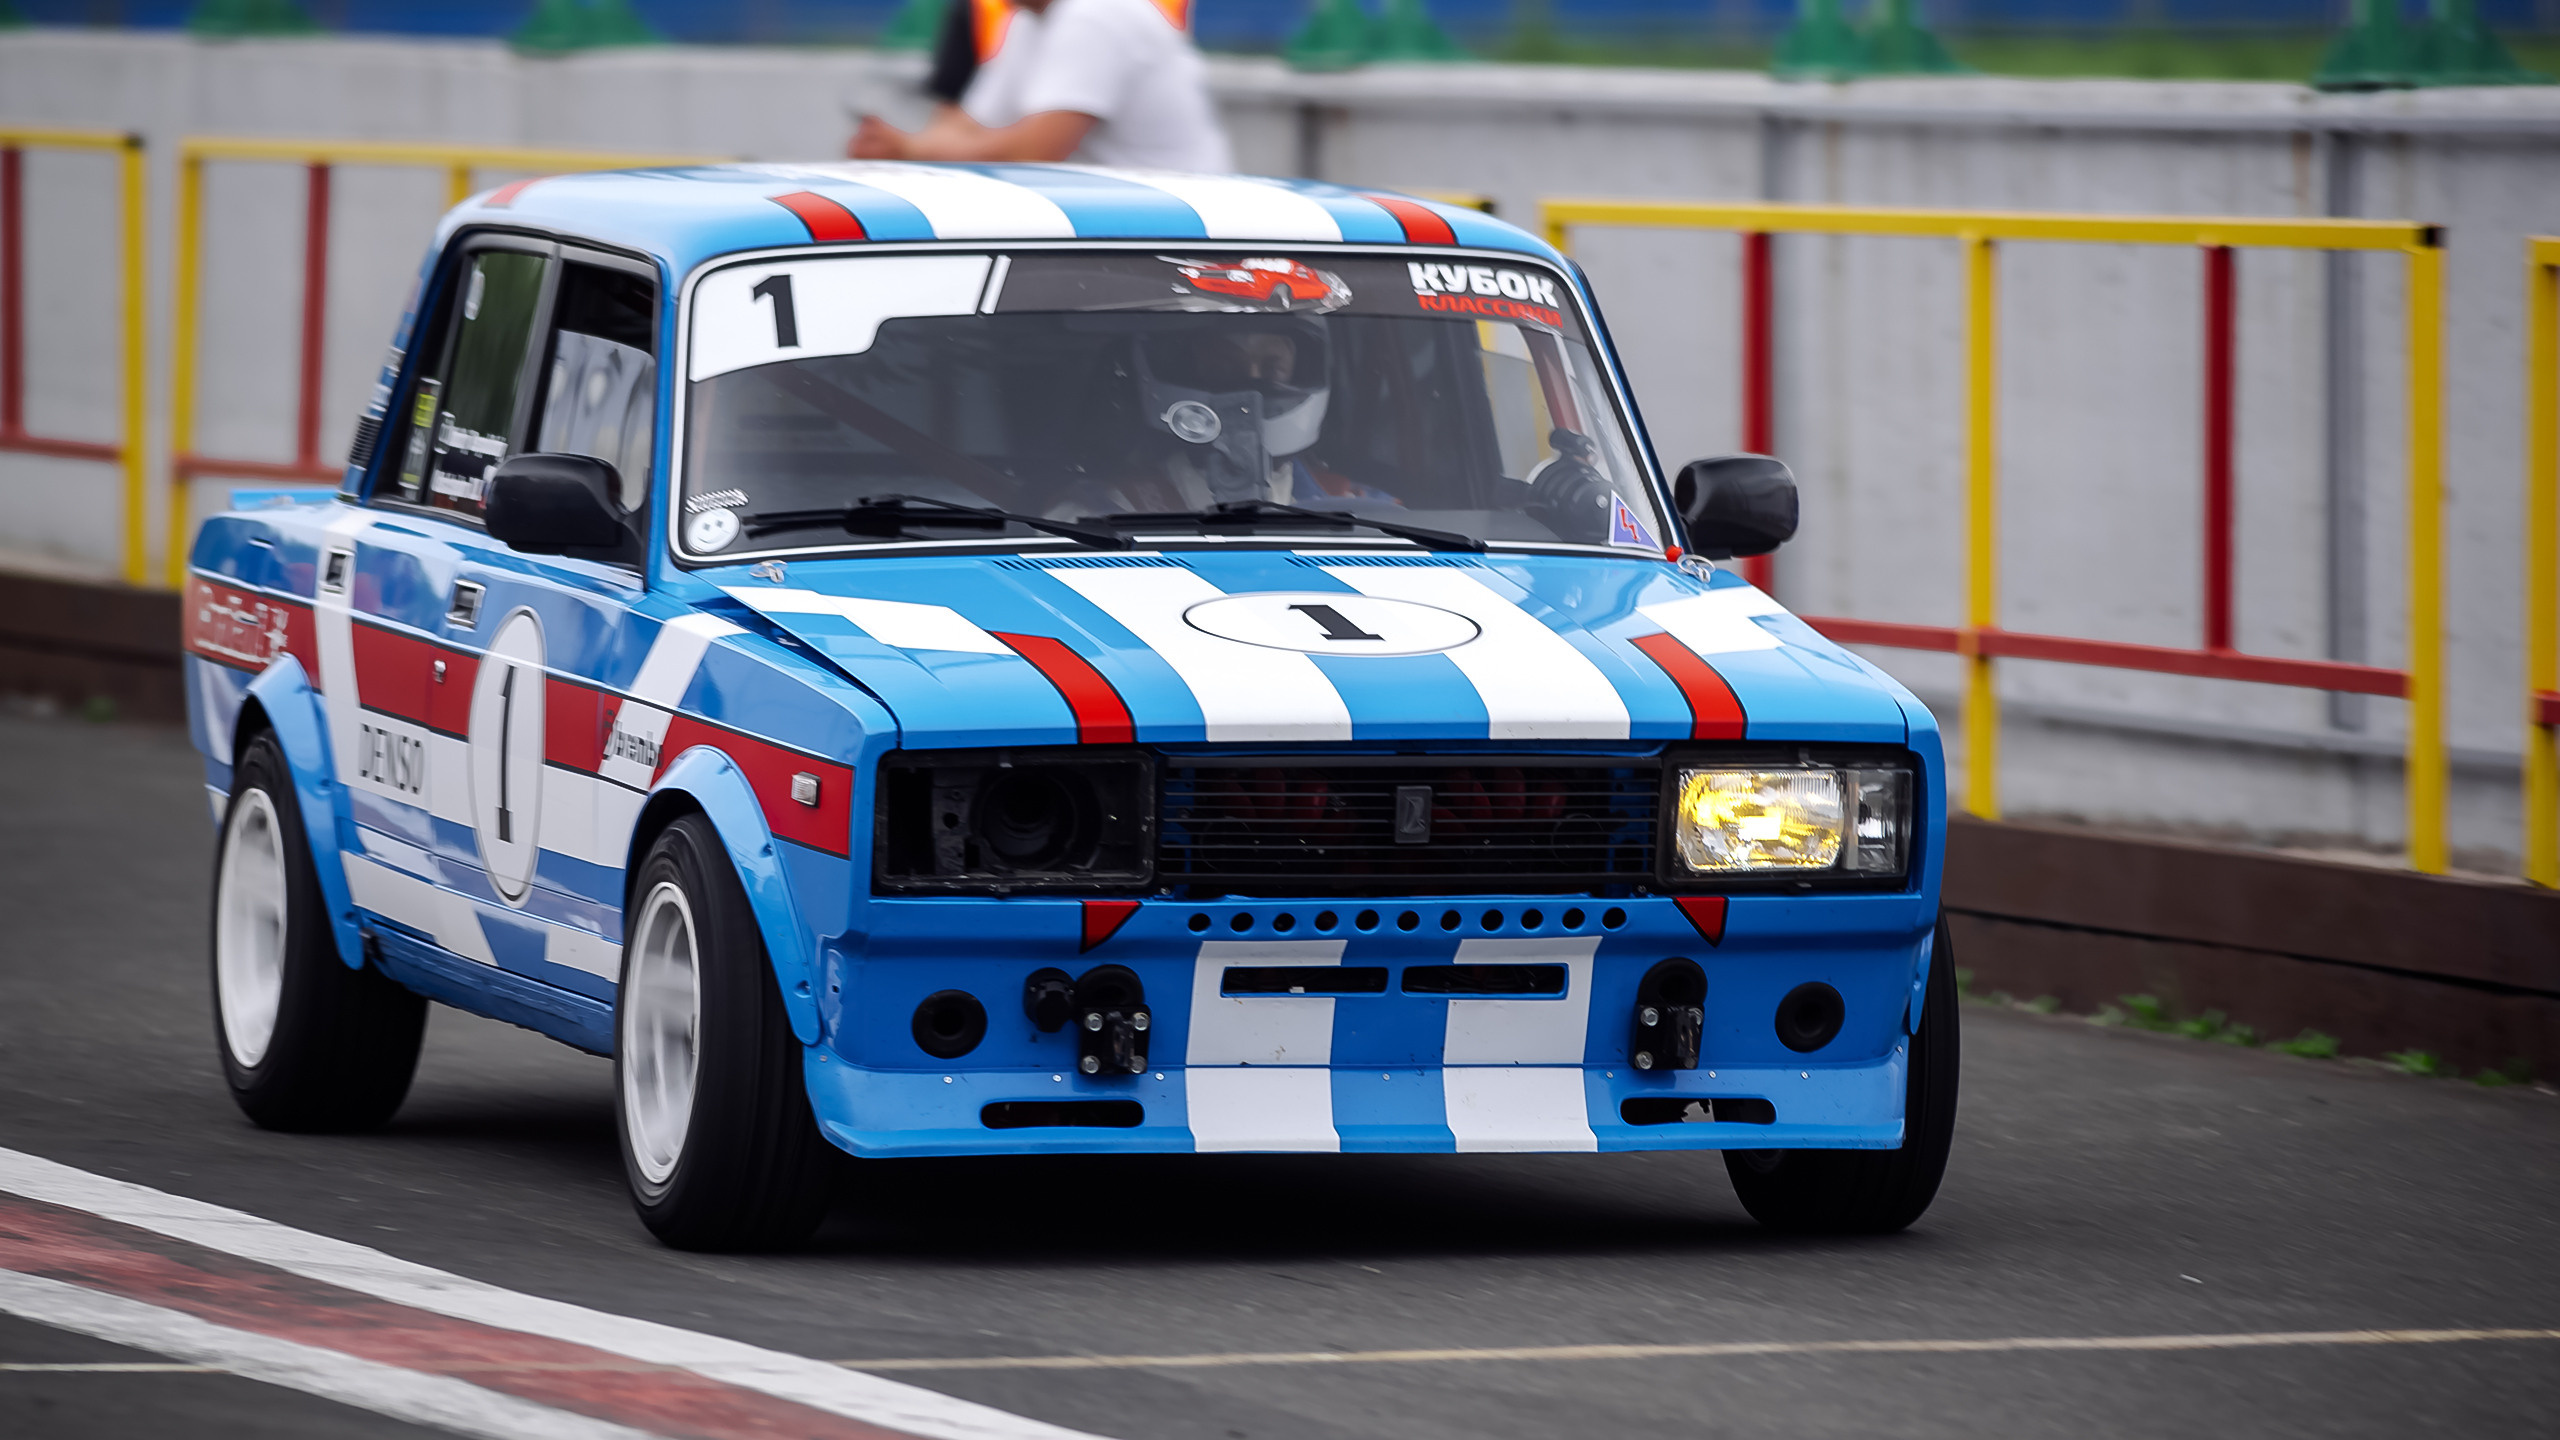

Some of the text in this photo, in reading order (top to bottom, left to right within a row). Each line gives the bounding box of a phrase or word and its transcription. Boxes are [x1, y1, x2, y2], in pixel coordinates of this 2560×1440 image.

[753, 275, 799, 347] 1
[1407, 262, 1559, 308] КУБОК
[1418, 295, 1563, 328] КЛАССИКИ
[1288, 604, 1385, 641] 1
[359, 722, 424, 795] DENSO
[496, 665, 515, 843] 1
